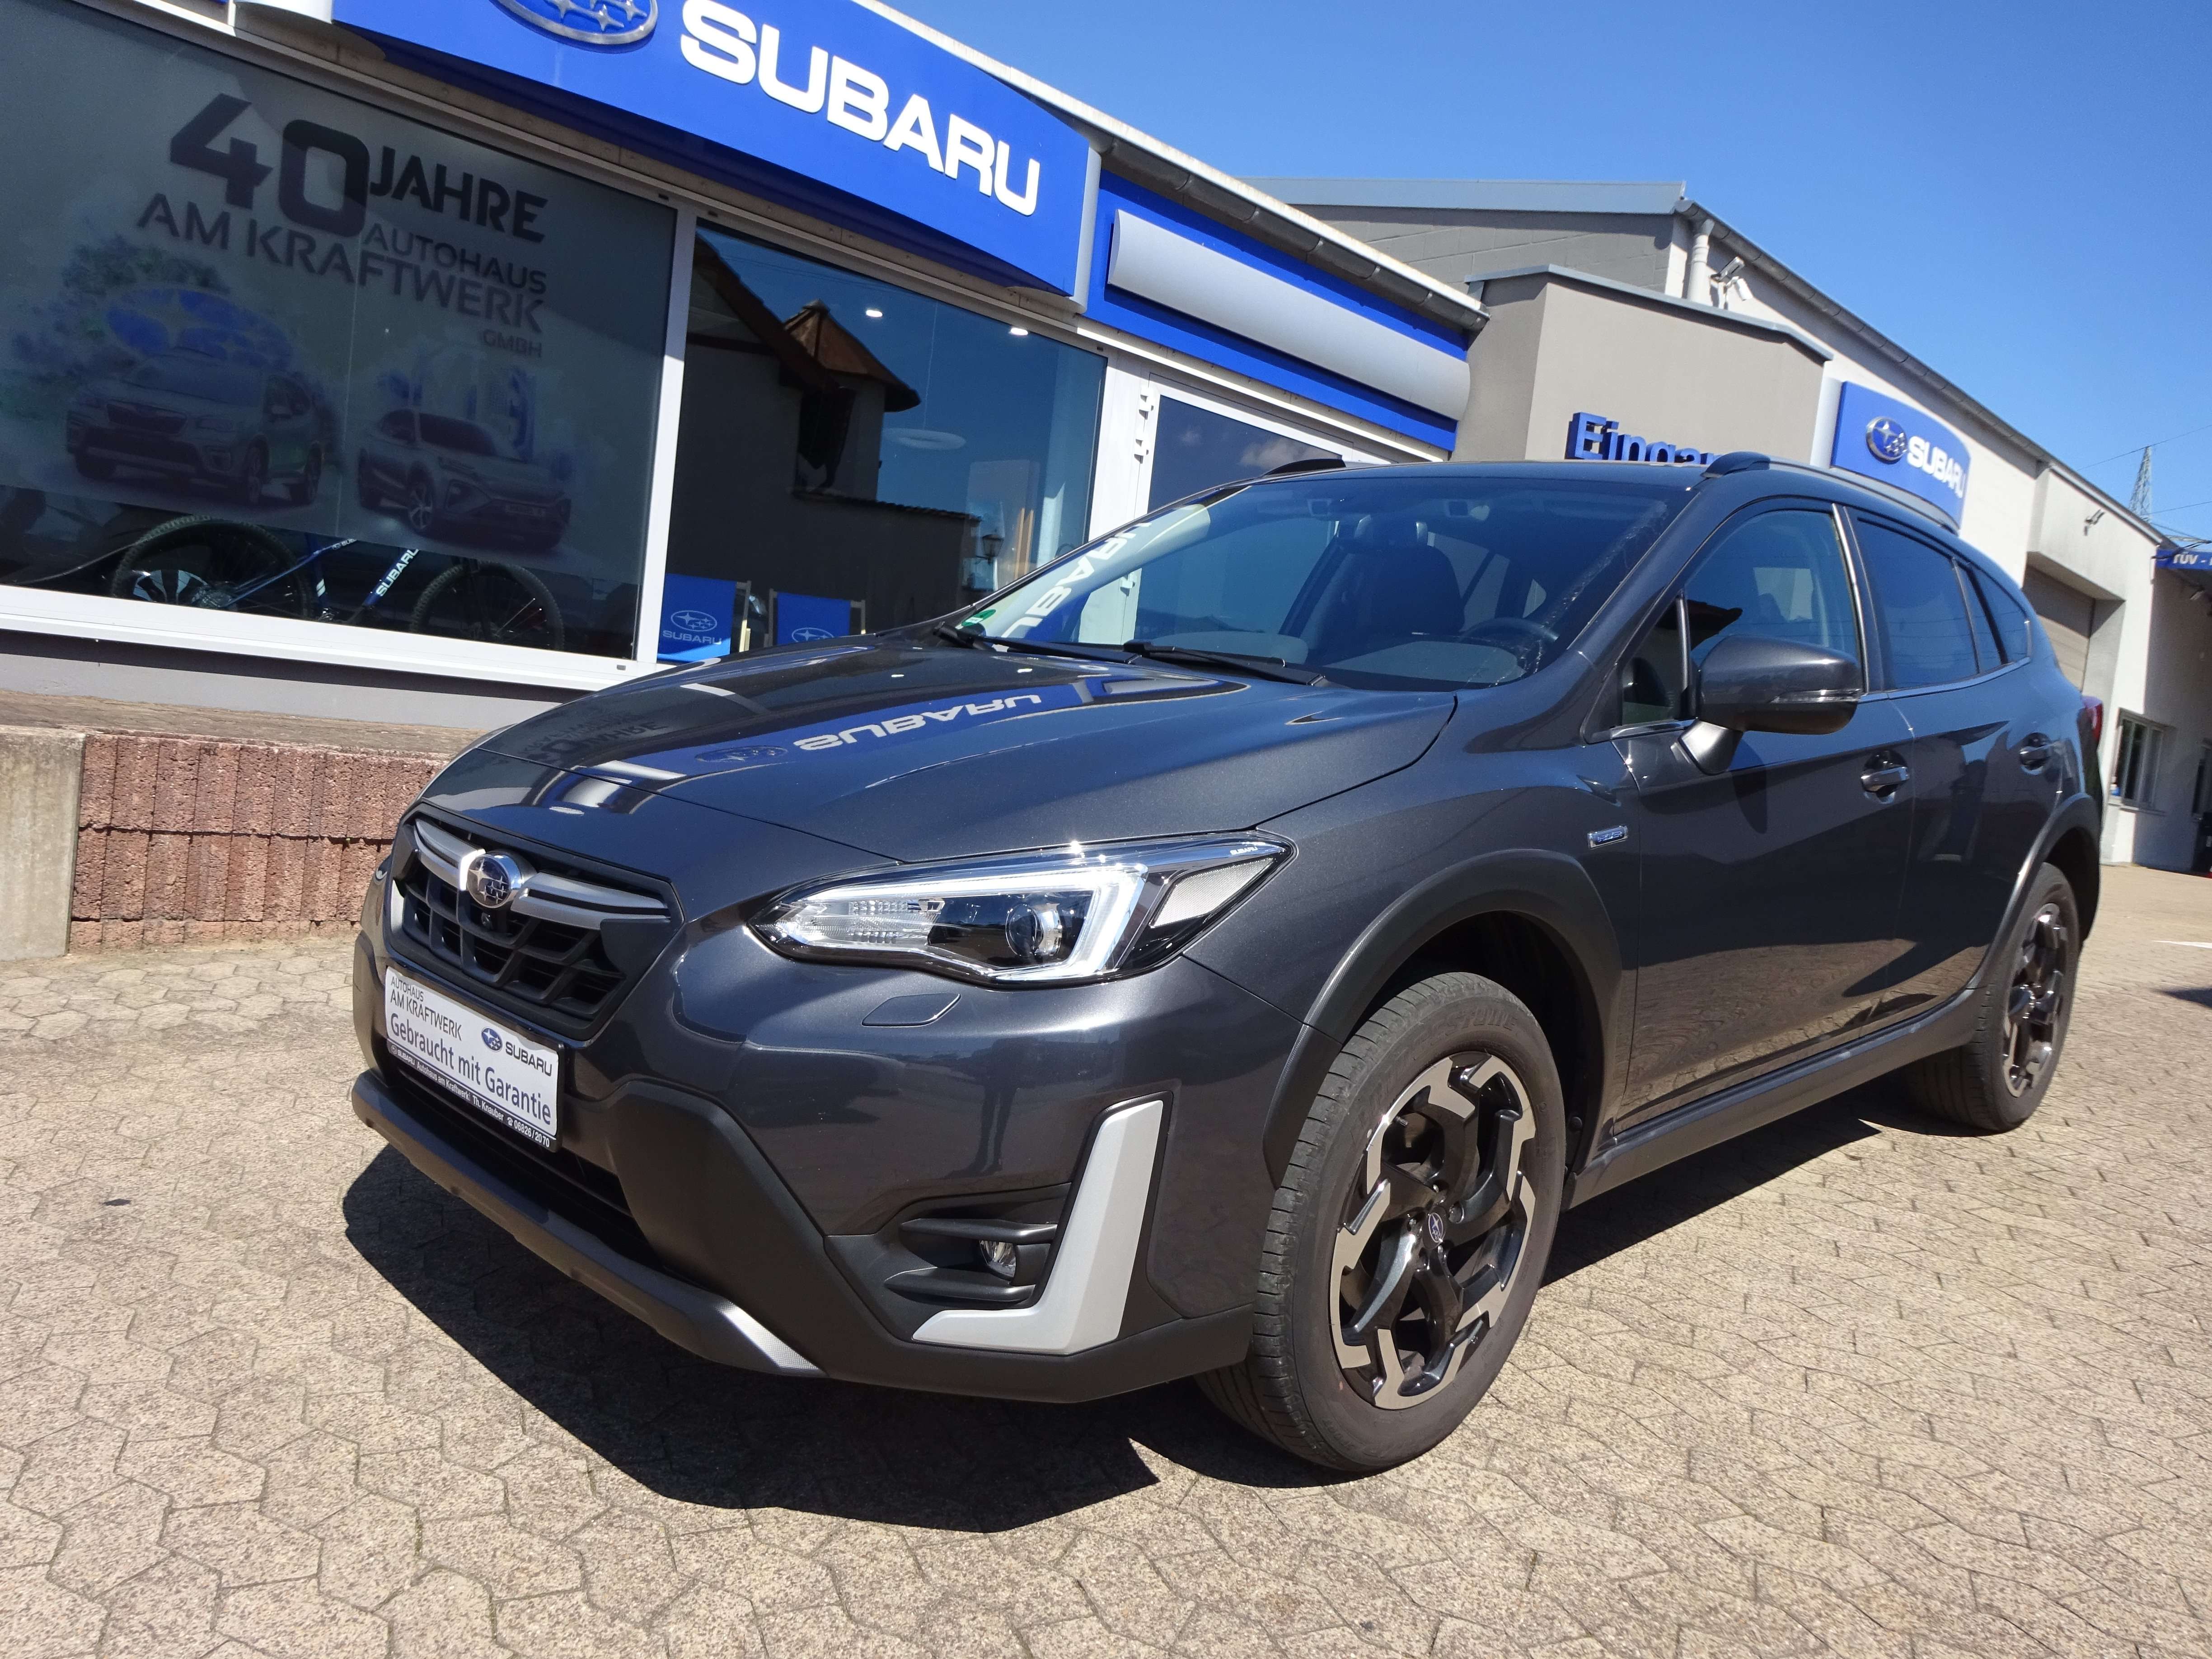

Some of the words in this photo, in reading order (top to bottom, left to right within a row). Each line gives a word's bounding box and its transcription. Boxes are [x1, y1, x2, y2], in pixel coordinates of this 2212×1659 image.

[680, 0, 1040, 216] SUBARU
[170, 93, 370, 238] 40
[370, 145, 548, 244] JAHRE
[136, 193, 230, 250] AM
[246, 219, 545, 333] KRAFTWERK
[362, 223, 548, 295] AUTOHAUS
[482, 328, 543, 358] GMBH
[1907, 436, 1965, 498] SUBARU
[663, 630, 722, 645] SUBARU
[1230, 846, 1258, 855] SUBARU
[390, 989, 404, 1009] AM
[407, 996, 462, 1041] KRAFTWERK
[391, 976, 424, 1002] AUTOHAUS
[391, 1012, 454, 1070] Gebraucht
[458, 1055, 481, 1085] mit
[485, 1066, 551, 1125] Garantie
[505, 1041, 552, 1077] SUBARU
[417, 1061, 438, 1081] Autohaus
[438, 1076, 445, 1086] am
[472, 1095, 481, 1108] Th.
[482, 1101, 504, 1121] Knauber
